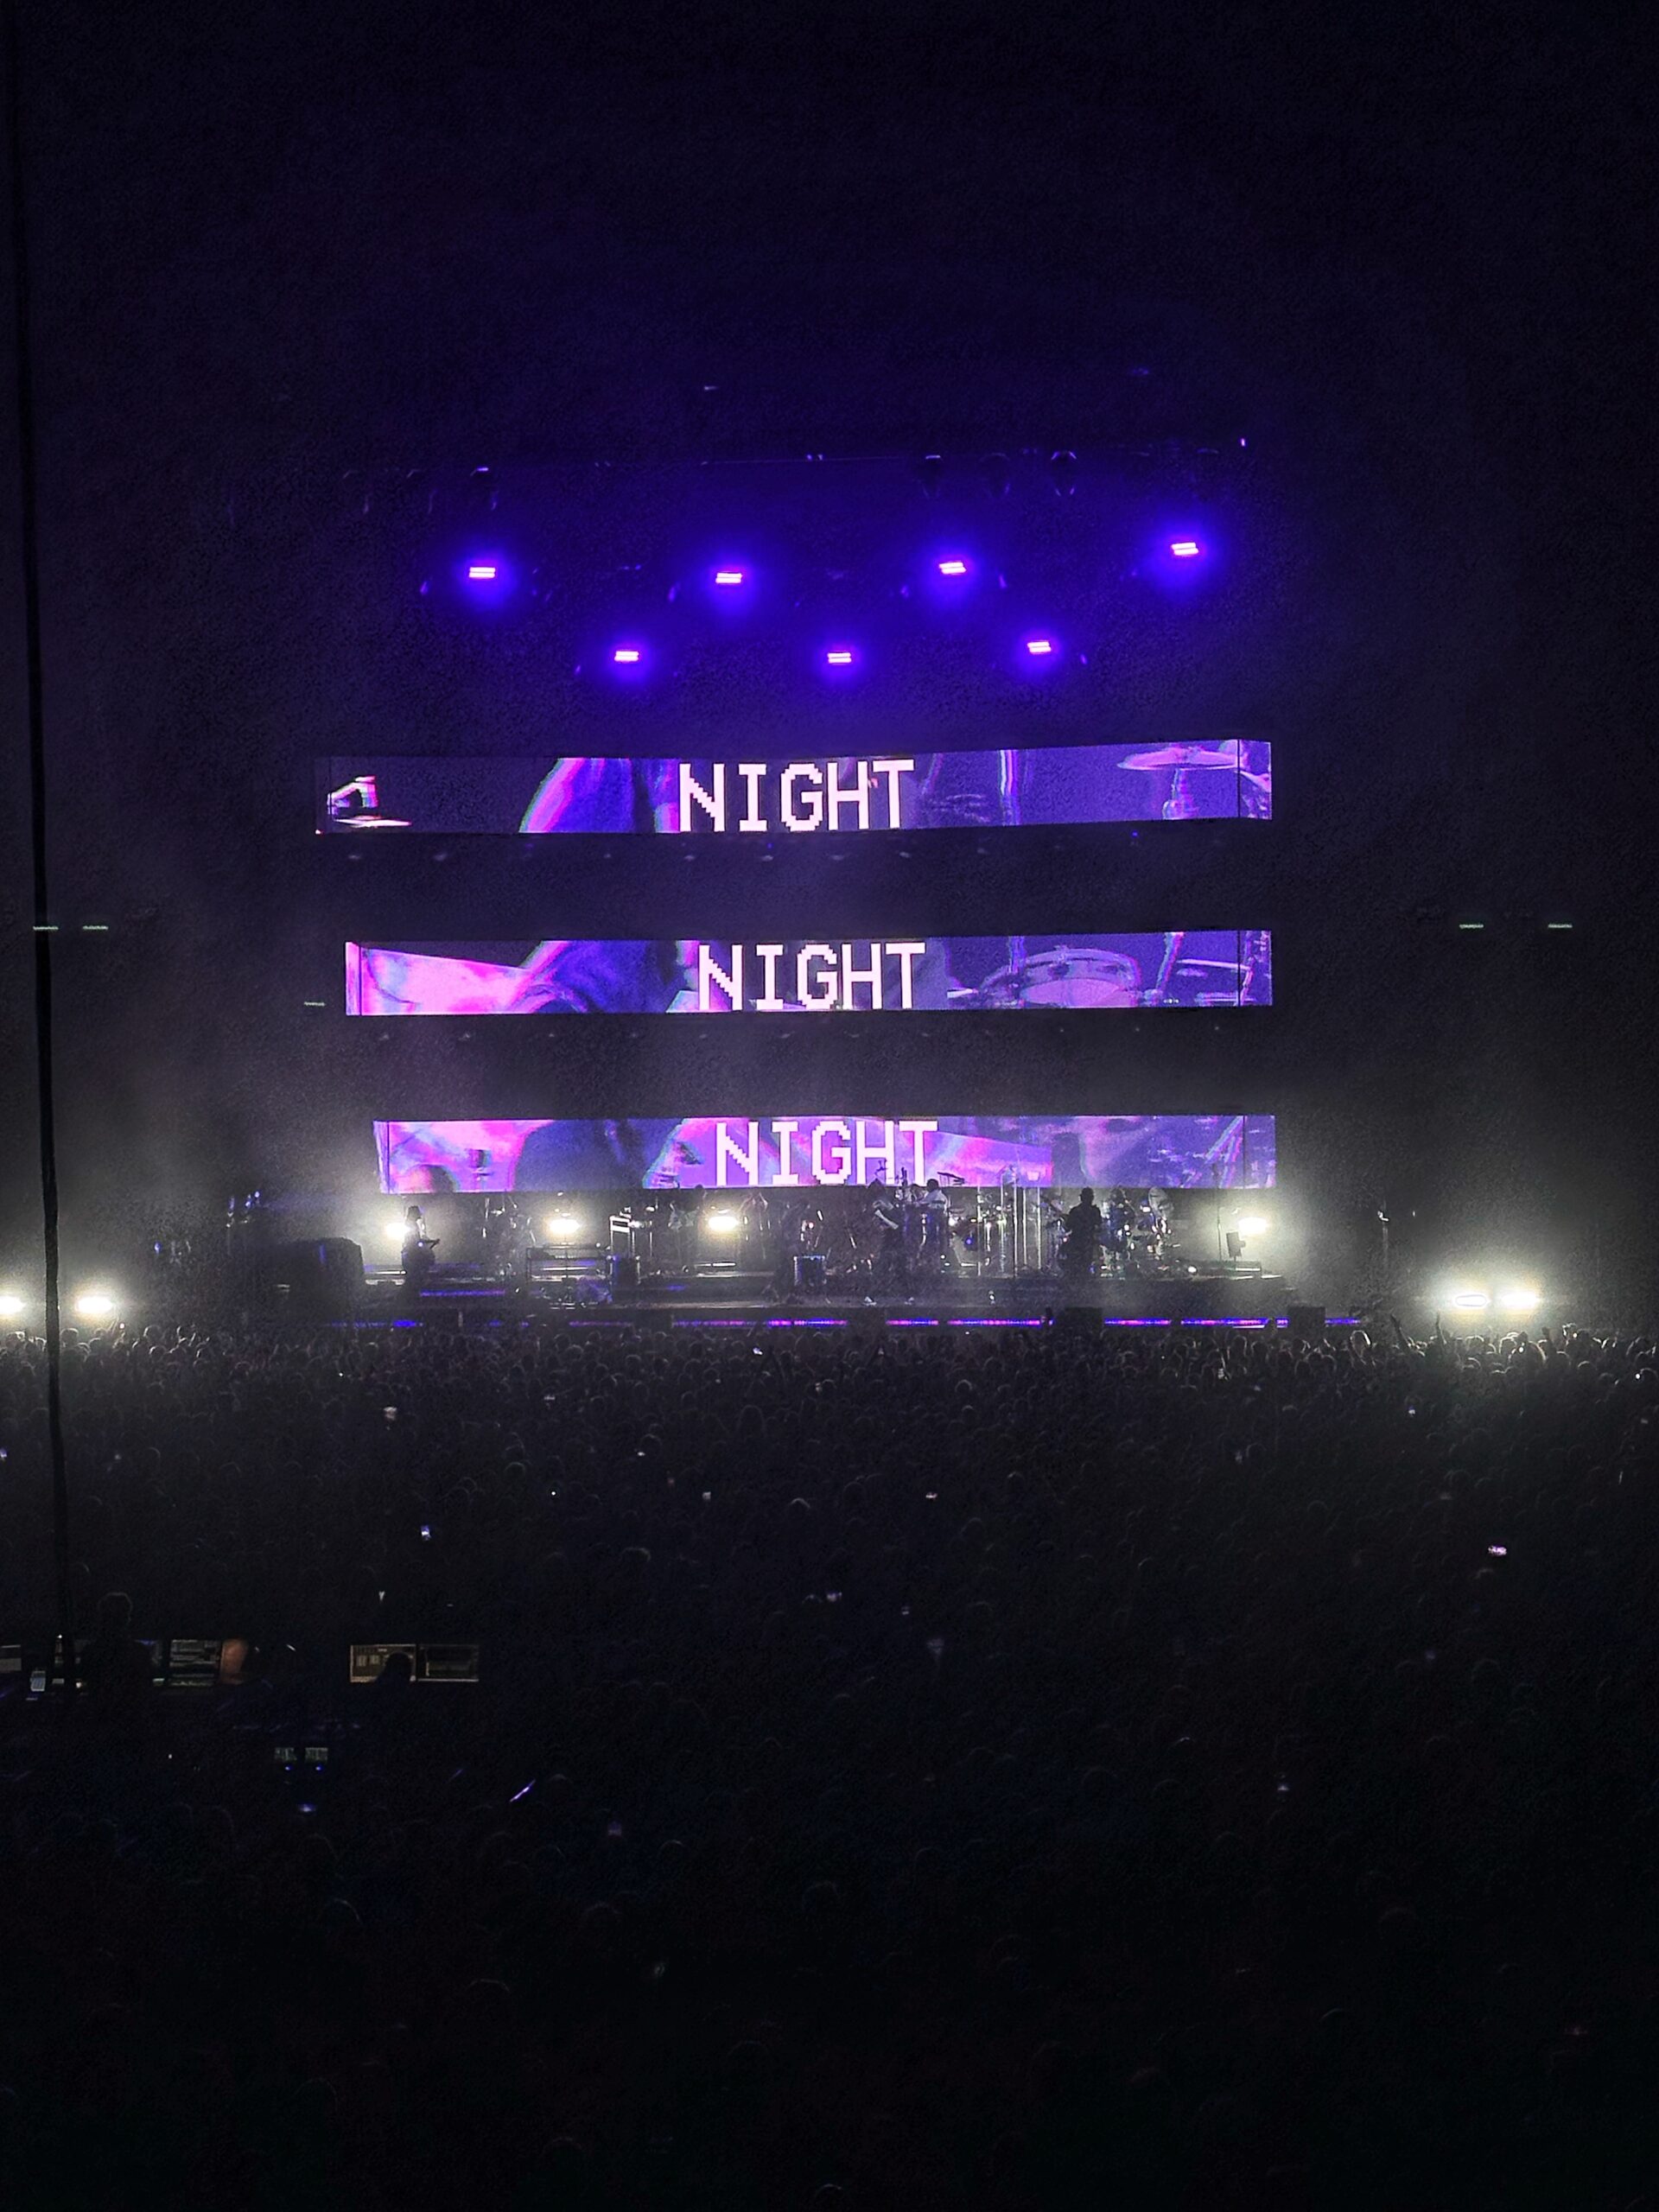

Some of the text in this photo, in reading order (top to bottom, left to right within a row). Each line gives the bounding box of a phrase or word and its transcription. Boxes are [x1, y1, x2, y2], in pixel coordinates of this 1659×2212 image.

[679, 759, 914, 832] NIGHT
[698, 942, 925, 1010] NIGHT
[715, 1121, 938, 1185] NIGHT
